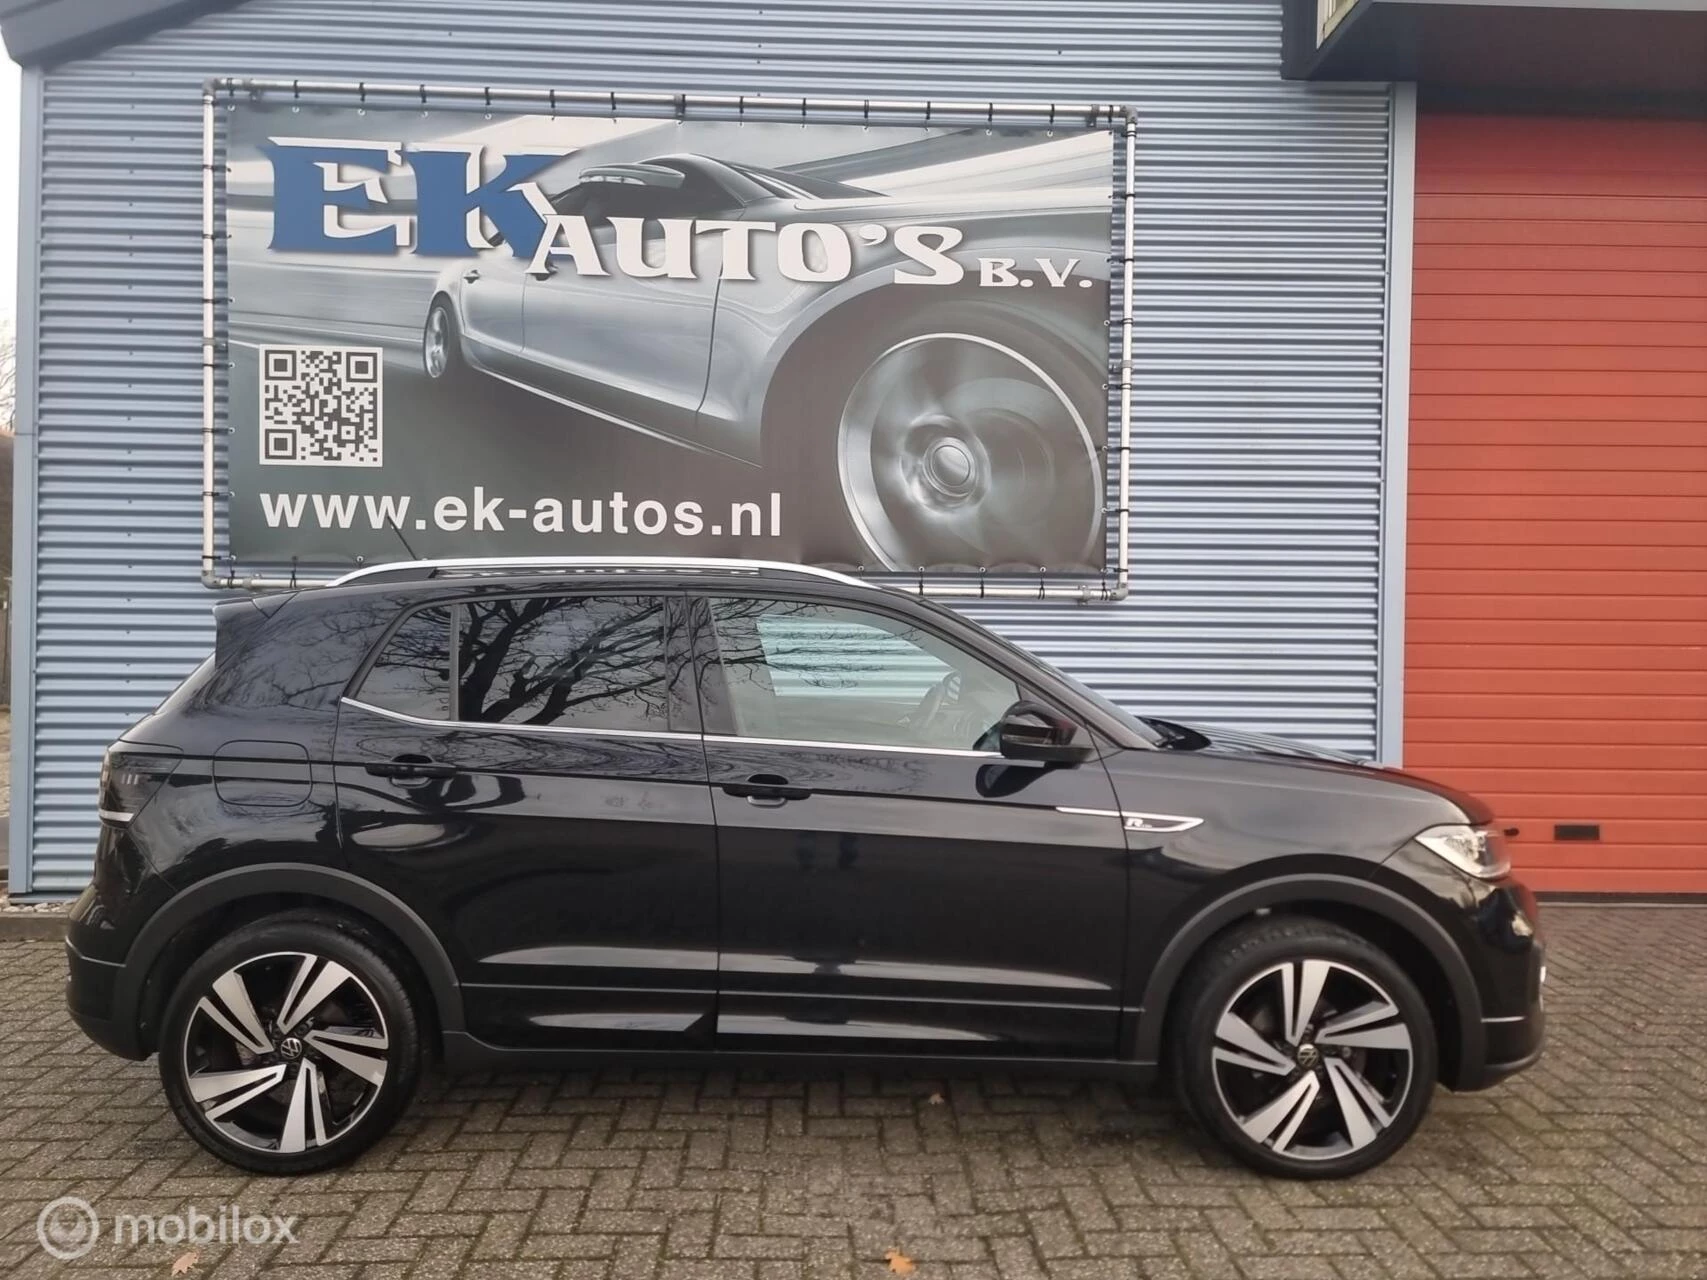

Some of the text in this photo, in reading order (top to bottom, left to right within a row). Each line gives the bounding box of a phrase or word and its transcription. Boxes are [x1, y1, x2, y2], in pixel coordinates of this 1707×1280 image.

[266, 136, 1094, 288] EK AUTO'S B.V.
[259, 487, 782, 537] www.ek-autos.nl
